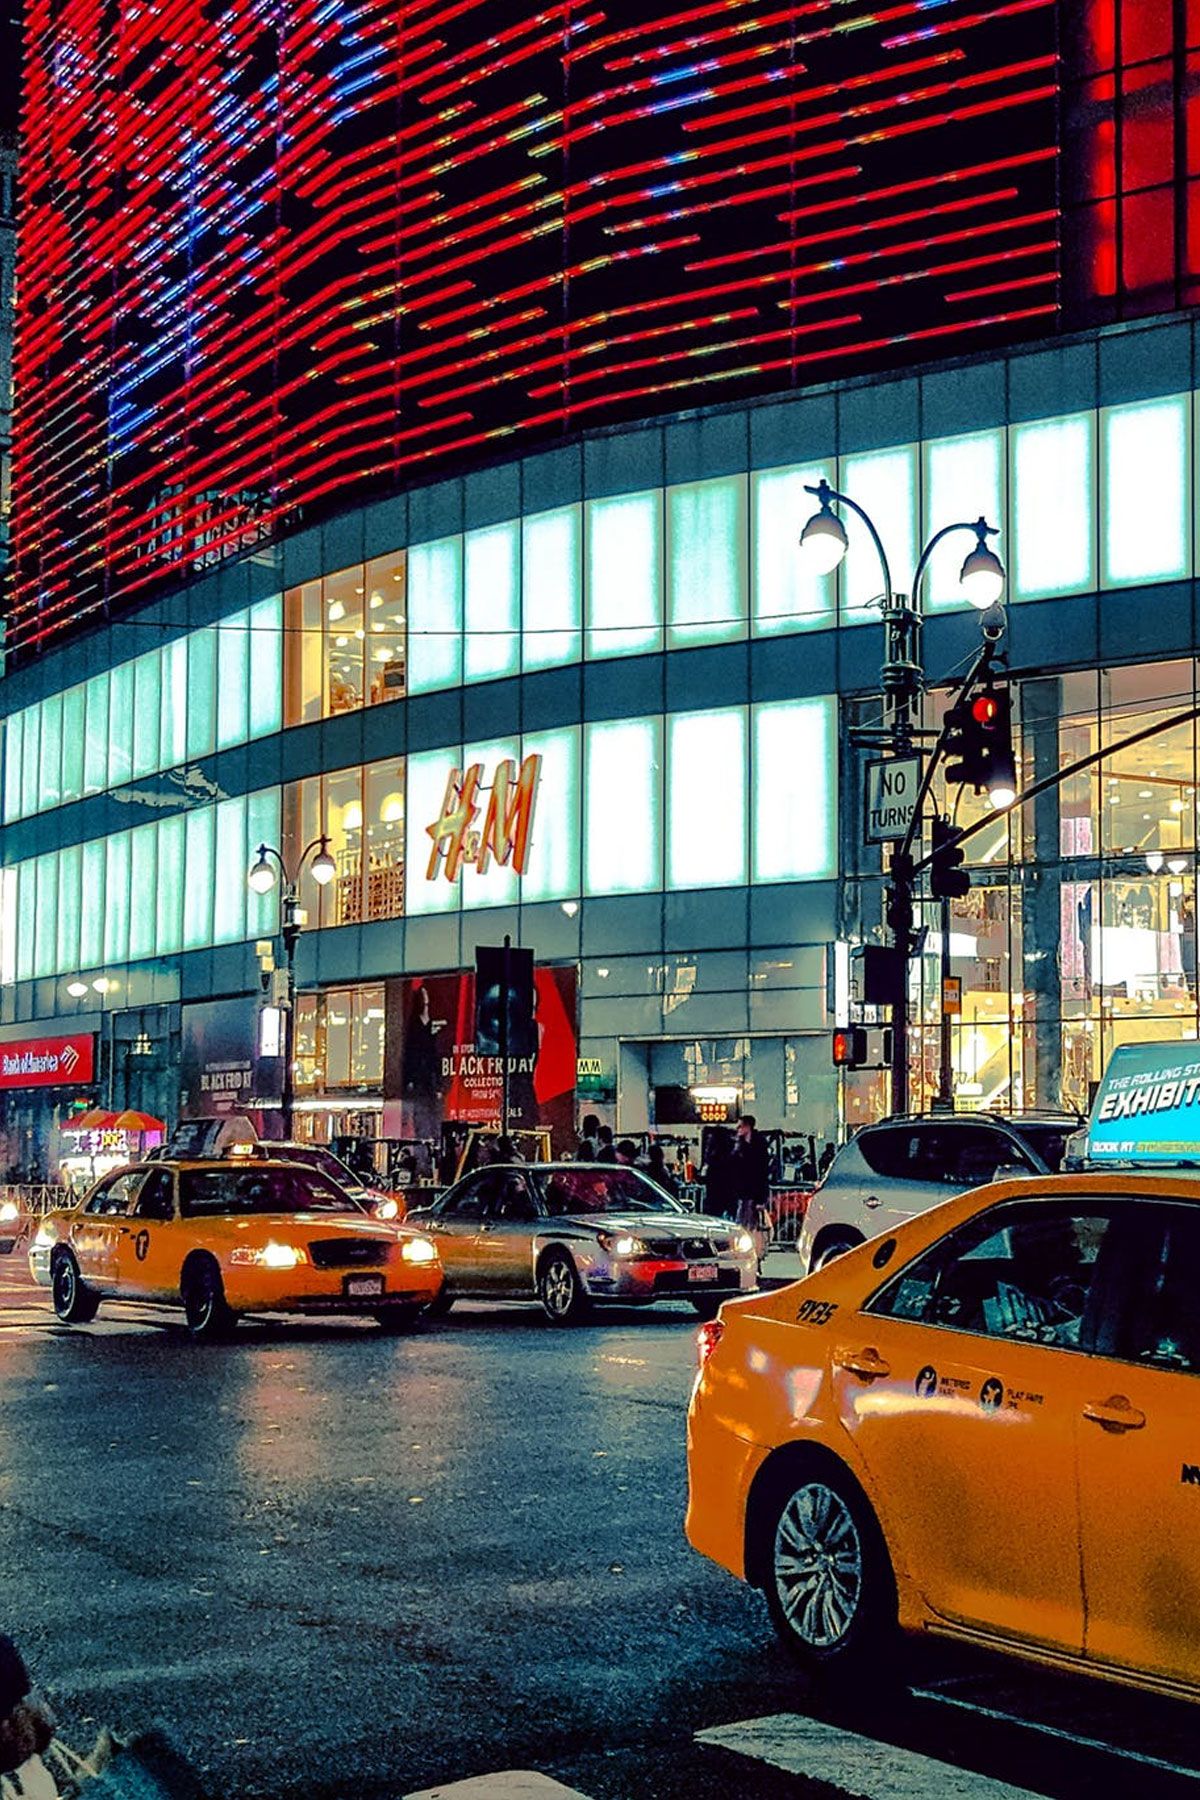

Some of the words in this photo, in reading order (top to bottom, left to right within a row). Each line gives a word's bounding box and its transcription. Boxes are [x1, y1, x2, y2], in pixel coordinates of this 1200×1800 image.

[881, 770, 906, 797] NO
[425, 754, 543, 883] H&M
[870, 804, 915, 829] TURNS
[3, 1053, 20, 1076] Bank
[29, 1051, 58, 1073] America
[441, 1055, 485, 1077] BLACK
[487, 1052, 536, 1075] FRDAY
[463, 1076, 504, 1089] COLLECTIO
[1108, 1077, 1129, 1091] THE
[1130, 1065, 1183, 1086] ROLLING
[796, 1299, 839, 1326] 9Y35
